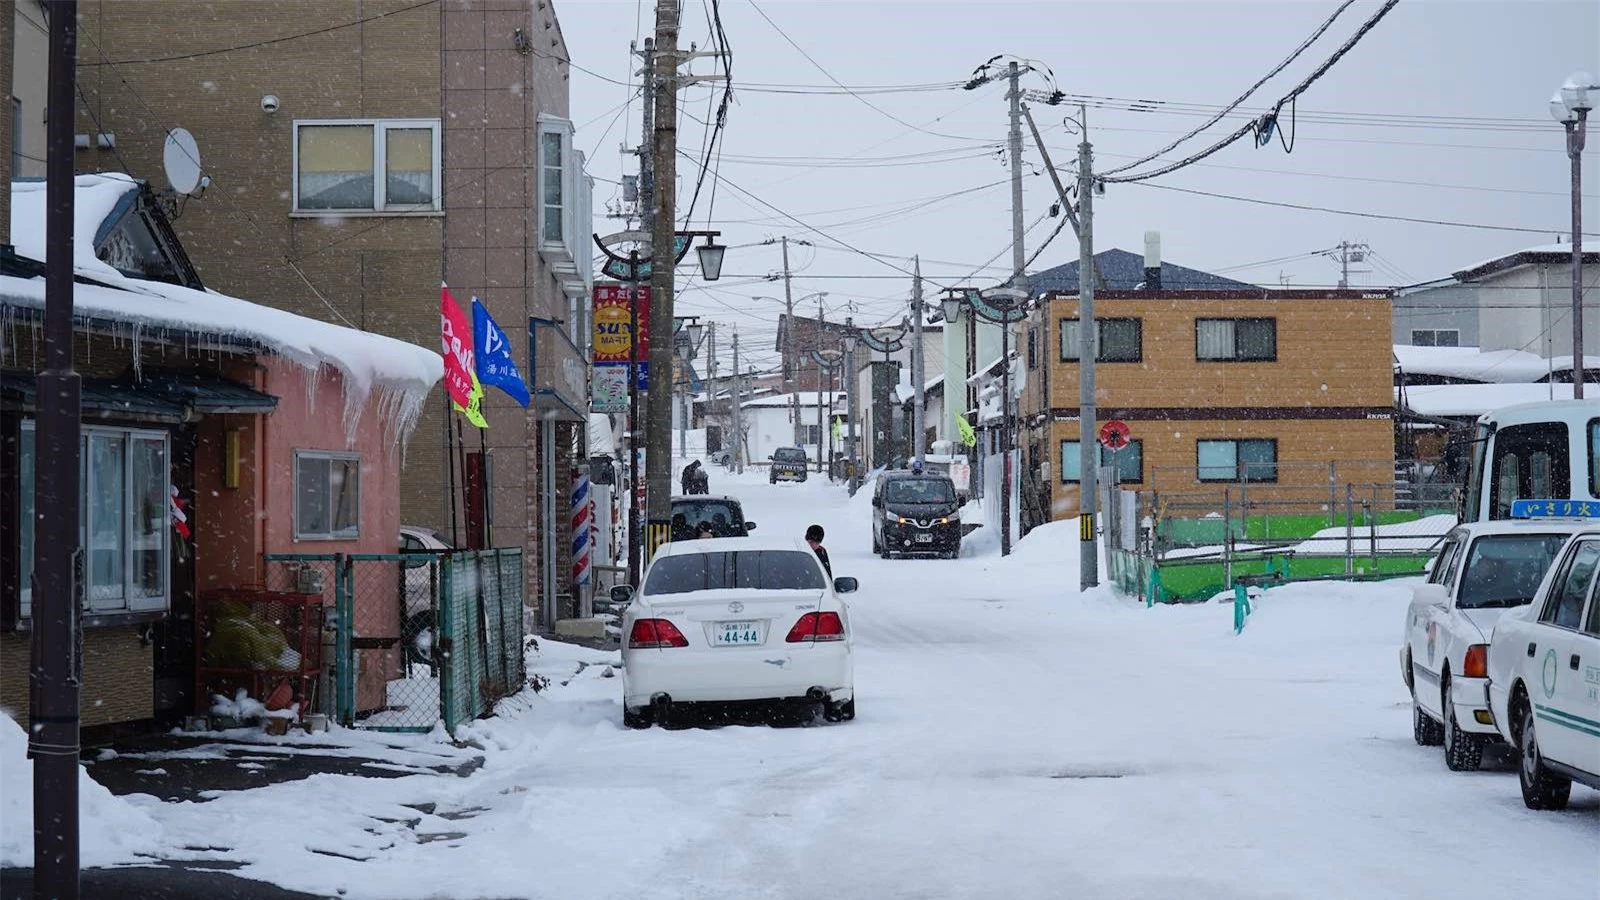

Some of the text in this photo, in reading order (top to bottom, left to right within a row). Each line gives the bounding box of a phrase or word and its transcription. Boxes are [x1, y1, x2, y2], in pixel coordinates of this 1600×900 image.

[1528, 502, 1592, 516] いさり火
[724, 630, 757, 643] 44-44
